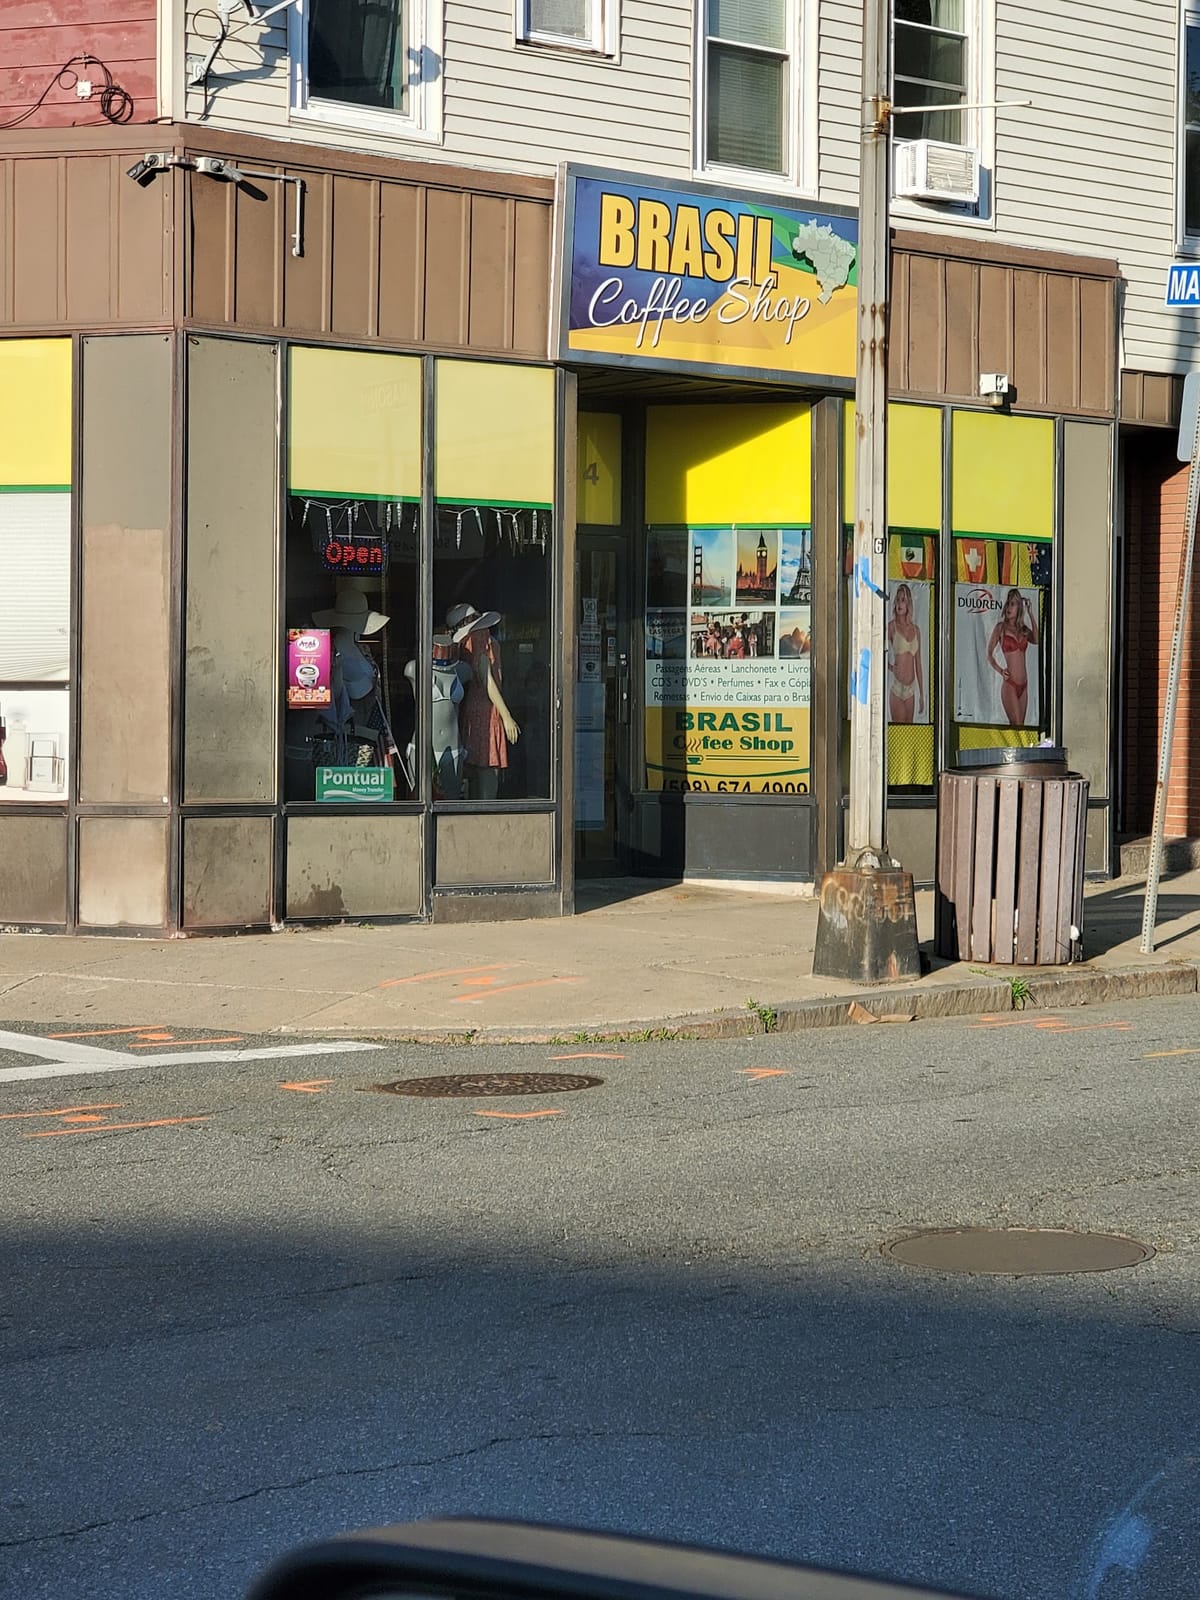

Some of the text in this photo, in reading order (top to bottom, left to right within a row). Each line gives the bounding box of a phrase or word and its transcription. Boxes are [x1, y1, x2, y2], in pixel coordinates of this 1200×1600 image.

[599, 192, 778, 289] BRASIL
[1170, 270, 1200, 300] MA
[588, 275, 810, 348] Coffee Shop
[326, 541, 382, 566] Open
[875, 539, 882, 553] 6
[958, 597, 1002, 610] DULOREN
[656, 663, 692, 676] Passagens
[695, 663, 721, 673] Aéreas
[731, 663, 777, 673] Lanchonete
[681, 677, 707, 687] DVD'S
[718, 677, 754, 687] Perfumes
[765, 677, 778, 688] Fax
[781, 680, 786, 688] e
[789, 677, 810, 690] Cópi
[701, 691, 722, 701] Envio
[724, 691, 734, 701] de
[736, 691, 762, 702] Caixas
[763, 694, 782, 704] para
[676, 712, 793, 732] BRASIL
[740, 735, 794, 753] Shop
[323, 768, 385, 785] Pontual
